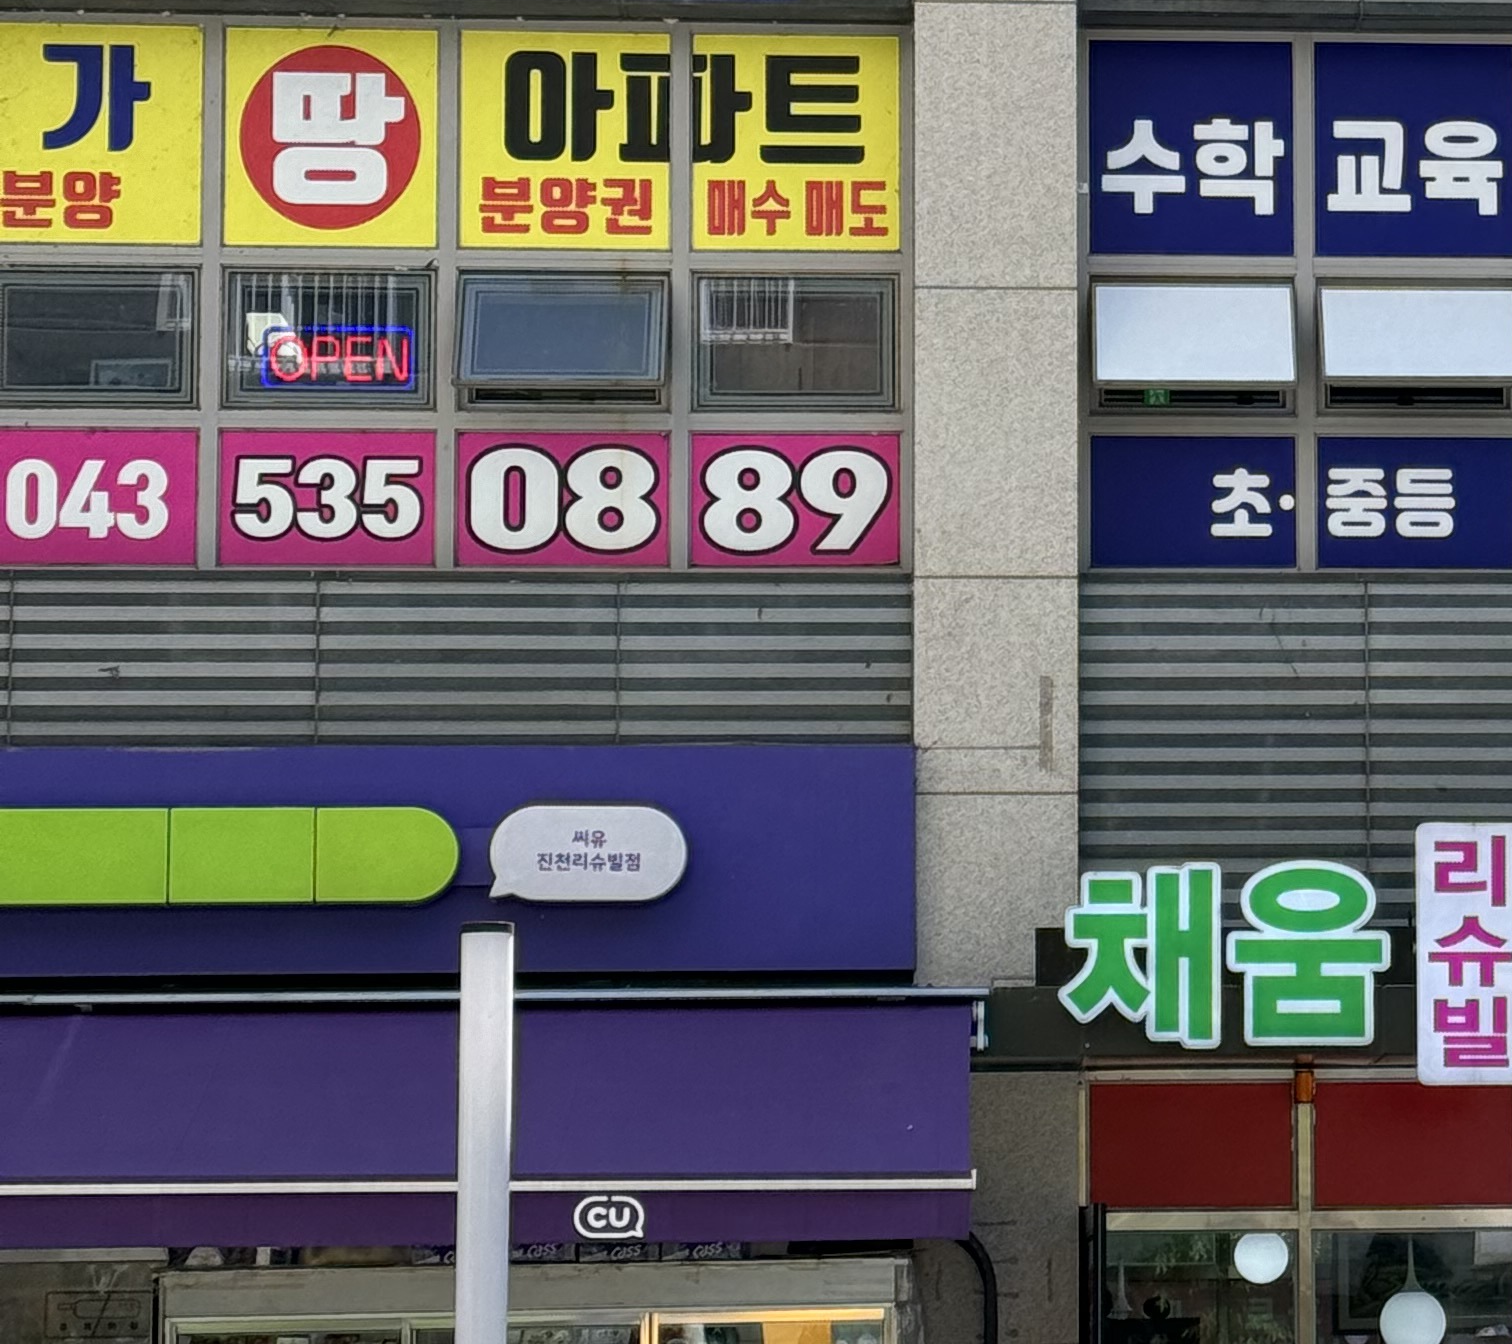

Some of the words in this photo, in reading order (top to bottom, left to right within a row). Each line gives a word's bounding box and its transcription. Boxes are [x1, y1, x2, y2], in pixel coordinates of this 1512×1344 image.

[43, 43, 151, 151] 가
[505, 50, 865, 163] 아파트
[271, 72, 405, 204] 땅
[1100, 118, 1285, 215] 수학
[1327, 119, 1505, 215] 교육
[0, 170, 120, 228] 분양
[479, 178, 653, 235] 분양권
[707, 181, 791, 236] 매수
[805, 182, 888, 237] 매도
[269, 336, 410, 383] OPEN
[5, 458, 169, 539] 043
[232, 455, 424, 540] 535
[537, 853, 641, 872] 진천리슈빌점
[572, 830, 607, 848] 씨유
[1057, 860, 1391, 1047] 채움
[586, 1206, 630, 1228] CU
